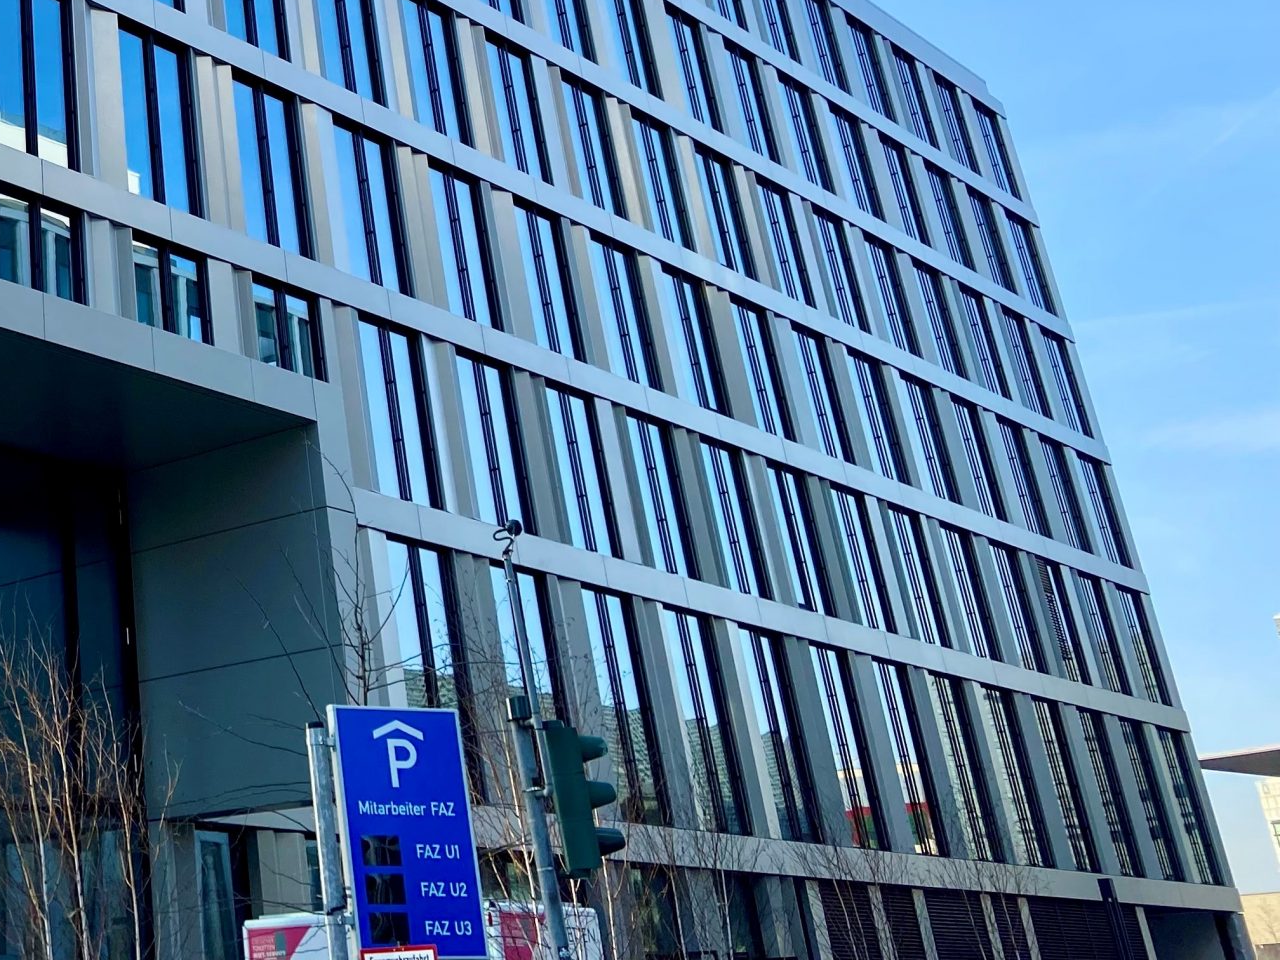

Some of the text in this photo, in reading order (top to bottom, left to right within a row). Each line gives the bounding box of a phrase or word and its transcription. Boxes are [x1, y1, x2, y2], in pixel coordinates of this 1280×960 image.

[386, 738, 418, 788] P
[358, 800, 456, 817] Mitarbeiter FAZ
[415, 843, 460, 859] FAZ U1
[420, 882, 468, 897] FAZ U2
[425, 920, 472, 936] FAZ U3
